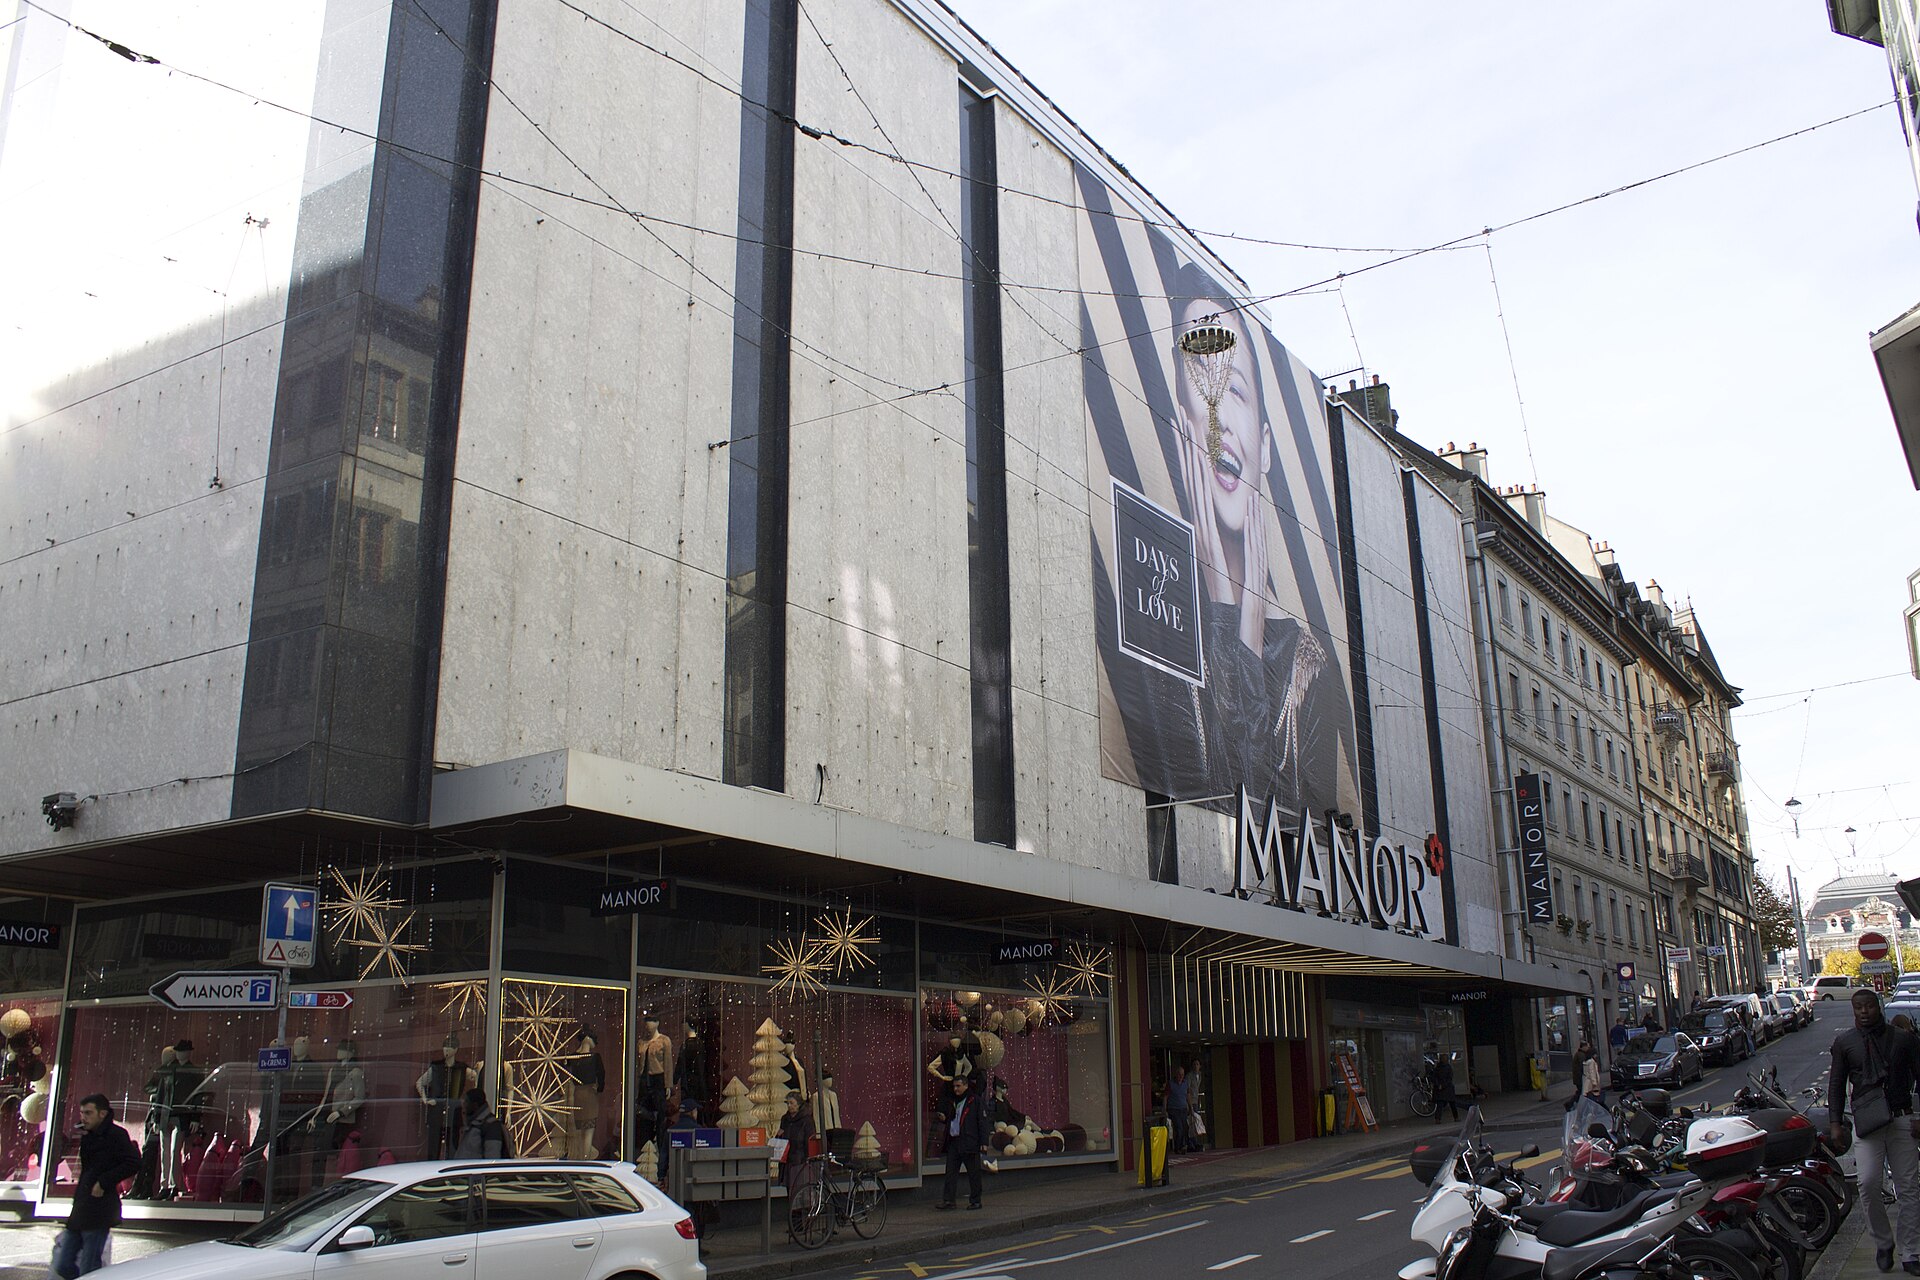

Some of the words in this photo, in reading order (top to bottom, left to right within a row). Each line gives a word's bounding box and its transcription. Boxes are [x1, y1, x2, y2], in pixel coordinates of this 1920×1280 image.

[1134, 536, 1179, 581] DAYS
[1152, 568, 1170, 606] of
[1137, 586, 1183, 631] LOVE
[1234, 782, 1435, 935] MANOR
[1524, 804, 1550, 918] MANOR
[600, 886, 660, 909] MANOR
[0, 925, 49, 944] ANOR
[1000, 943, 1053, 960] MANOR
[183, 984, 244, 999] MANOR
[256, 985, 265, 1000] P
[1451, 991, 1487, 1002] MANOR
